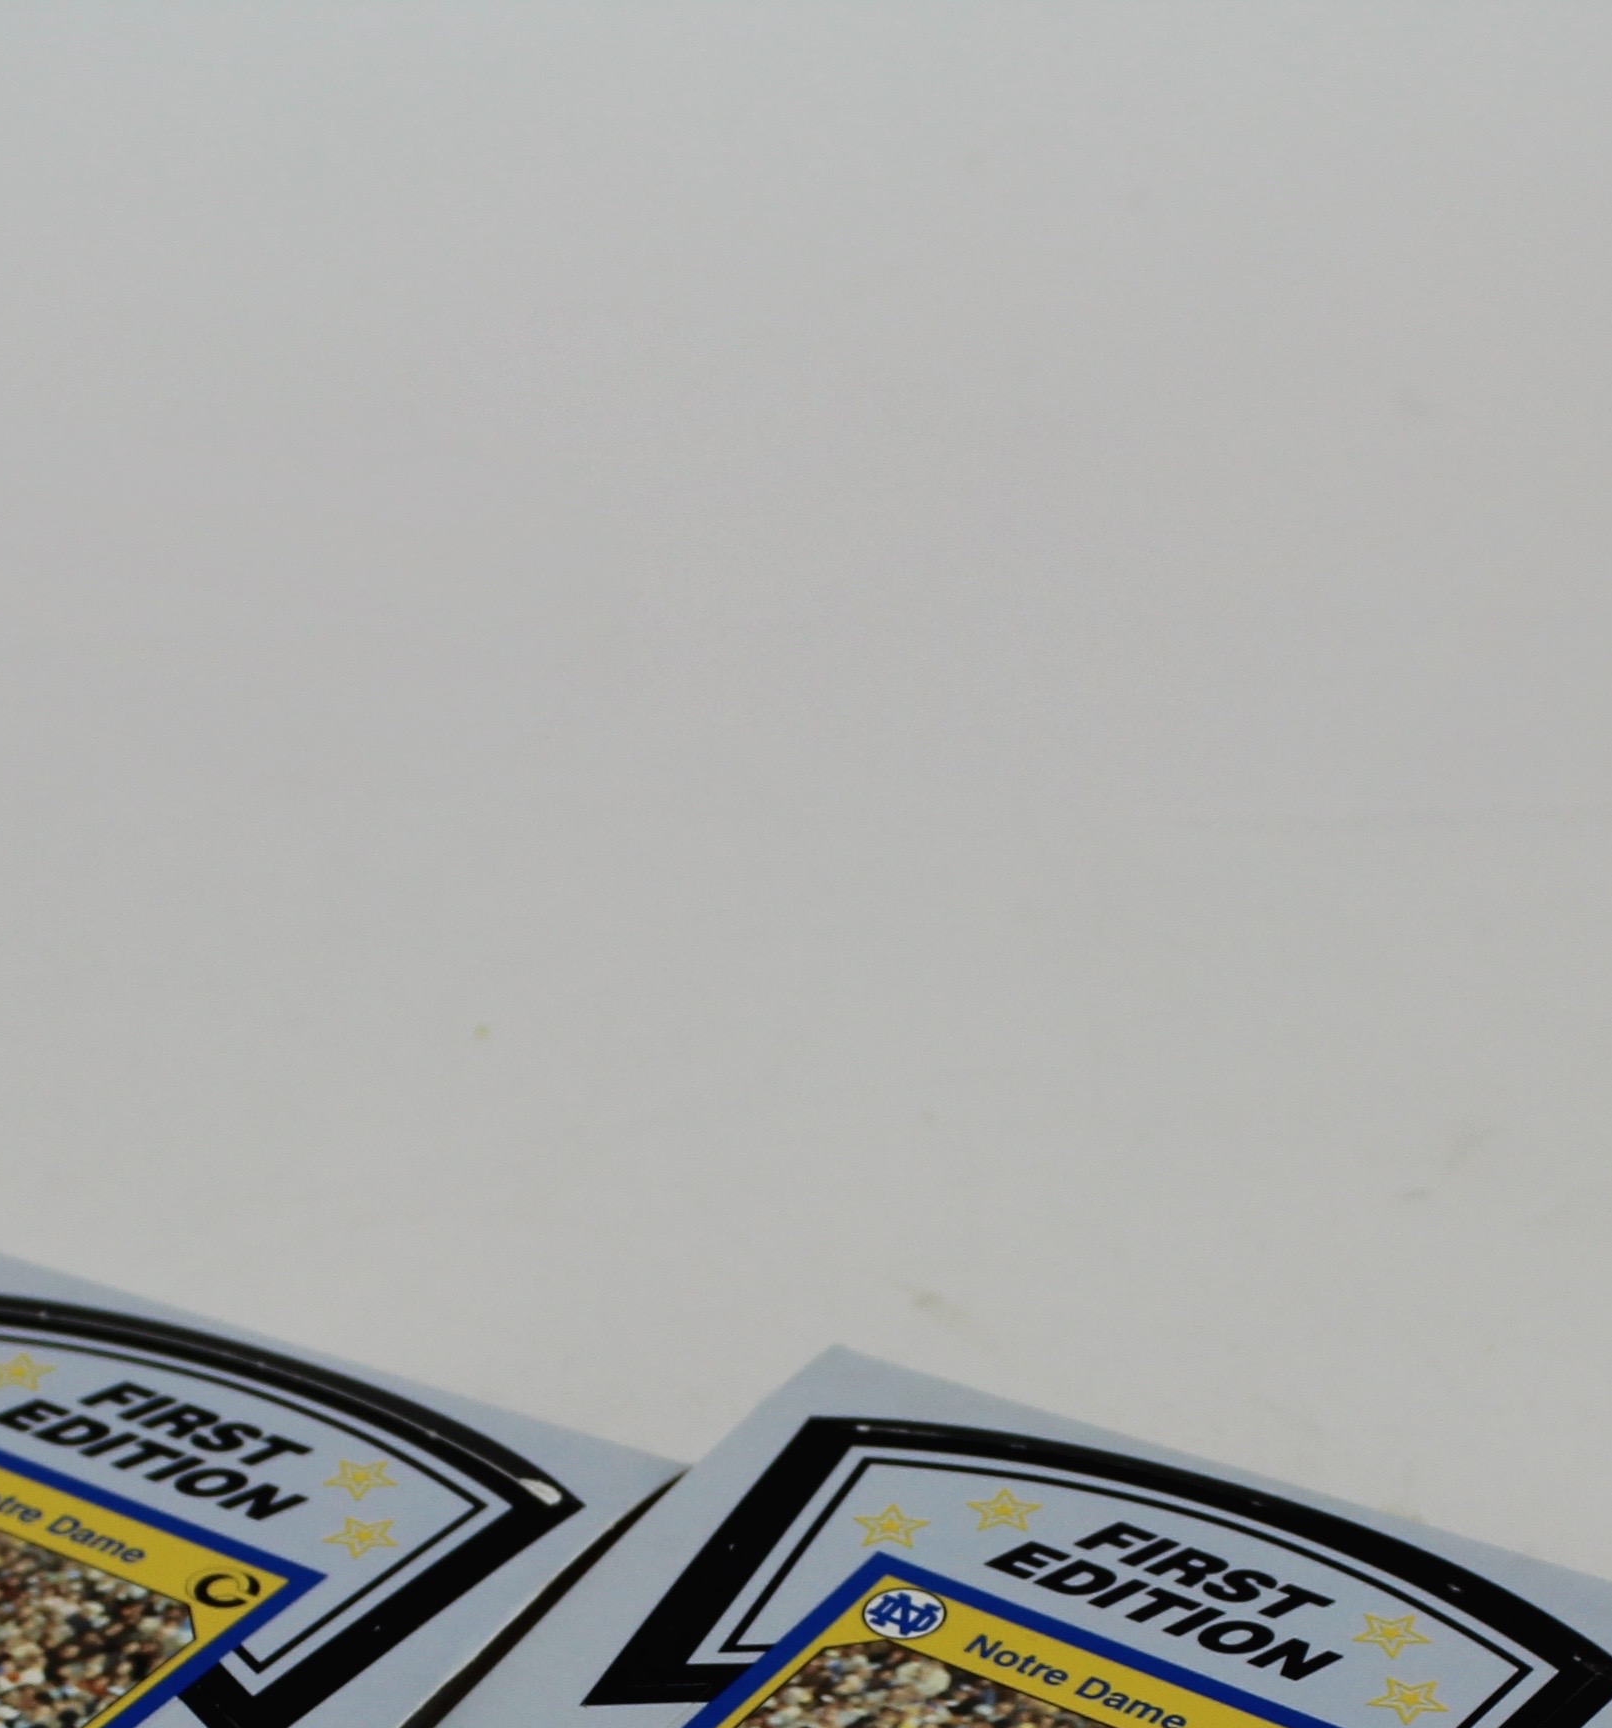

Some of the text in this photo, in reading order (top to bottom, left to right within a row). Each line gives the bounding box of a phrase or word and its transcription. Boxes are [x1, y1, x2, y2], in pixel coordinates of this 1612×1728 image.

[78, 1382, 314, 1466] FIRST
[45, 1514, 146, 1564] Dame
[1074, 1522, 1336, 1621] FIRST
[984, 1541, 1344, 1682] EDITION
[963, 1634, 1069, 1686] Notre
